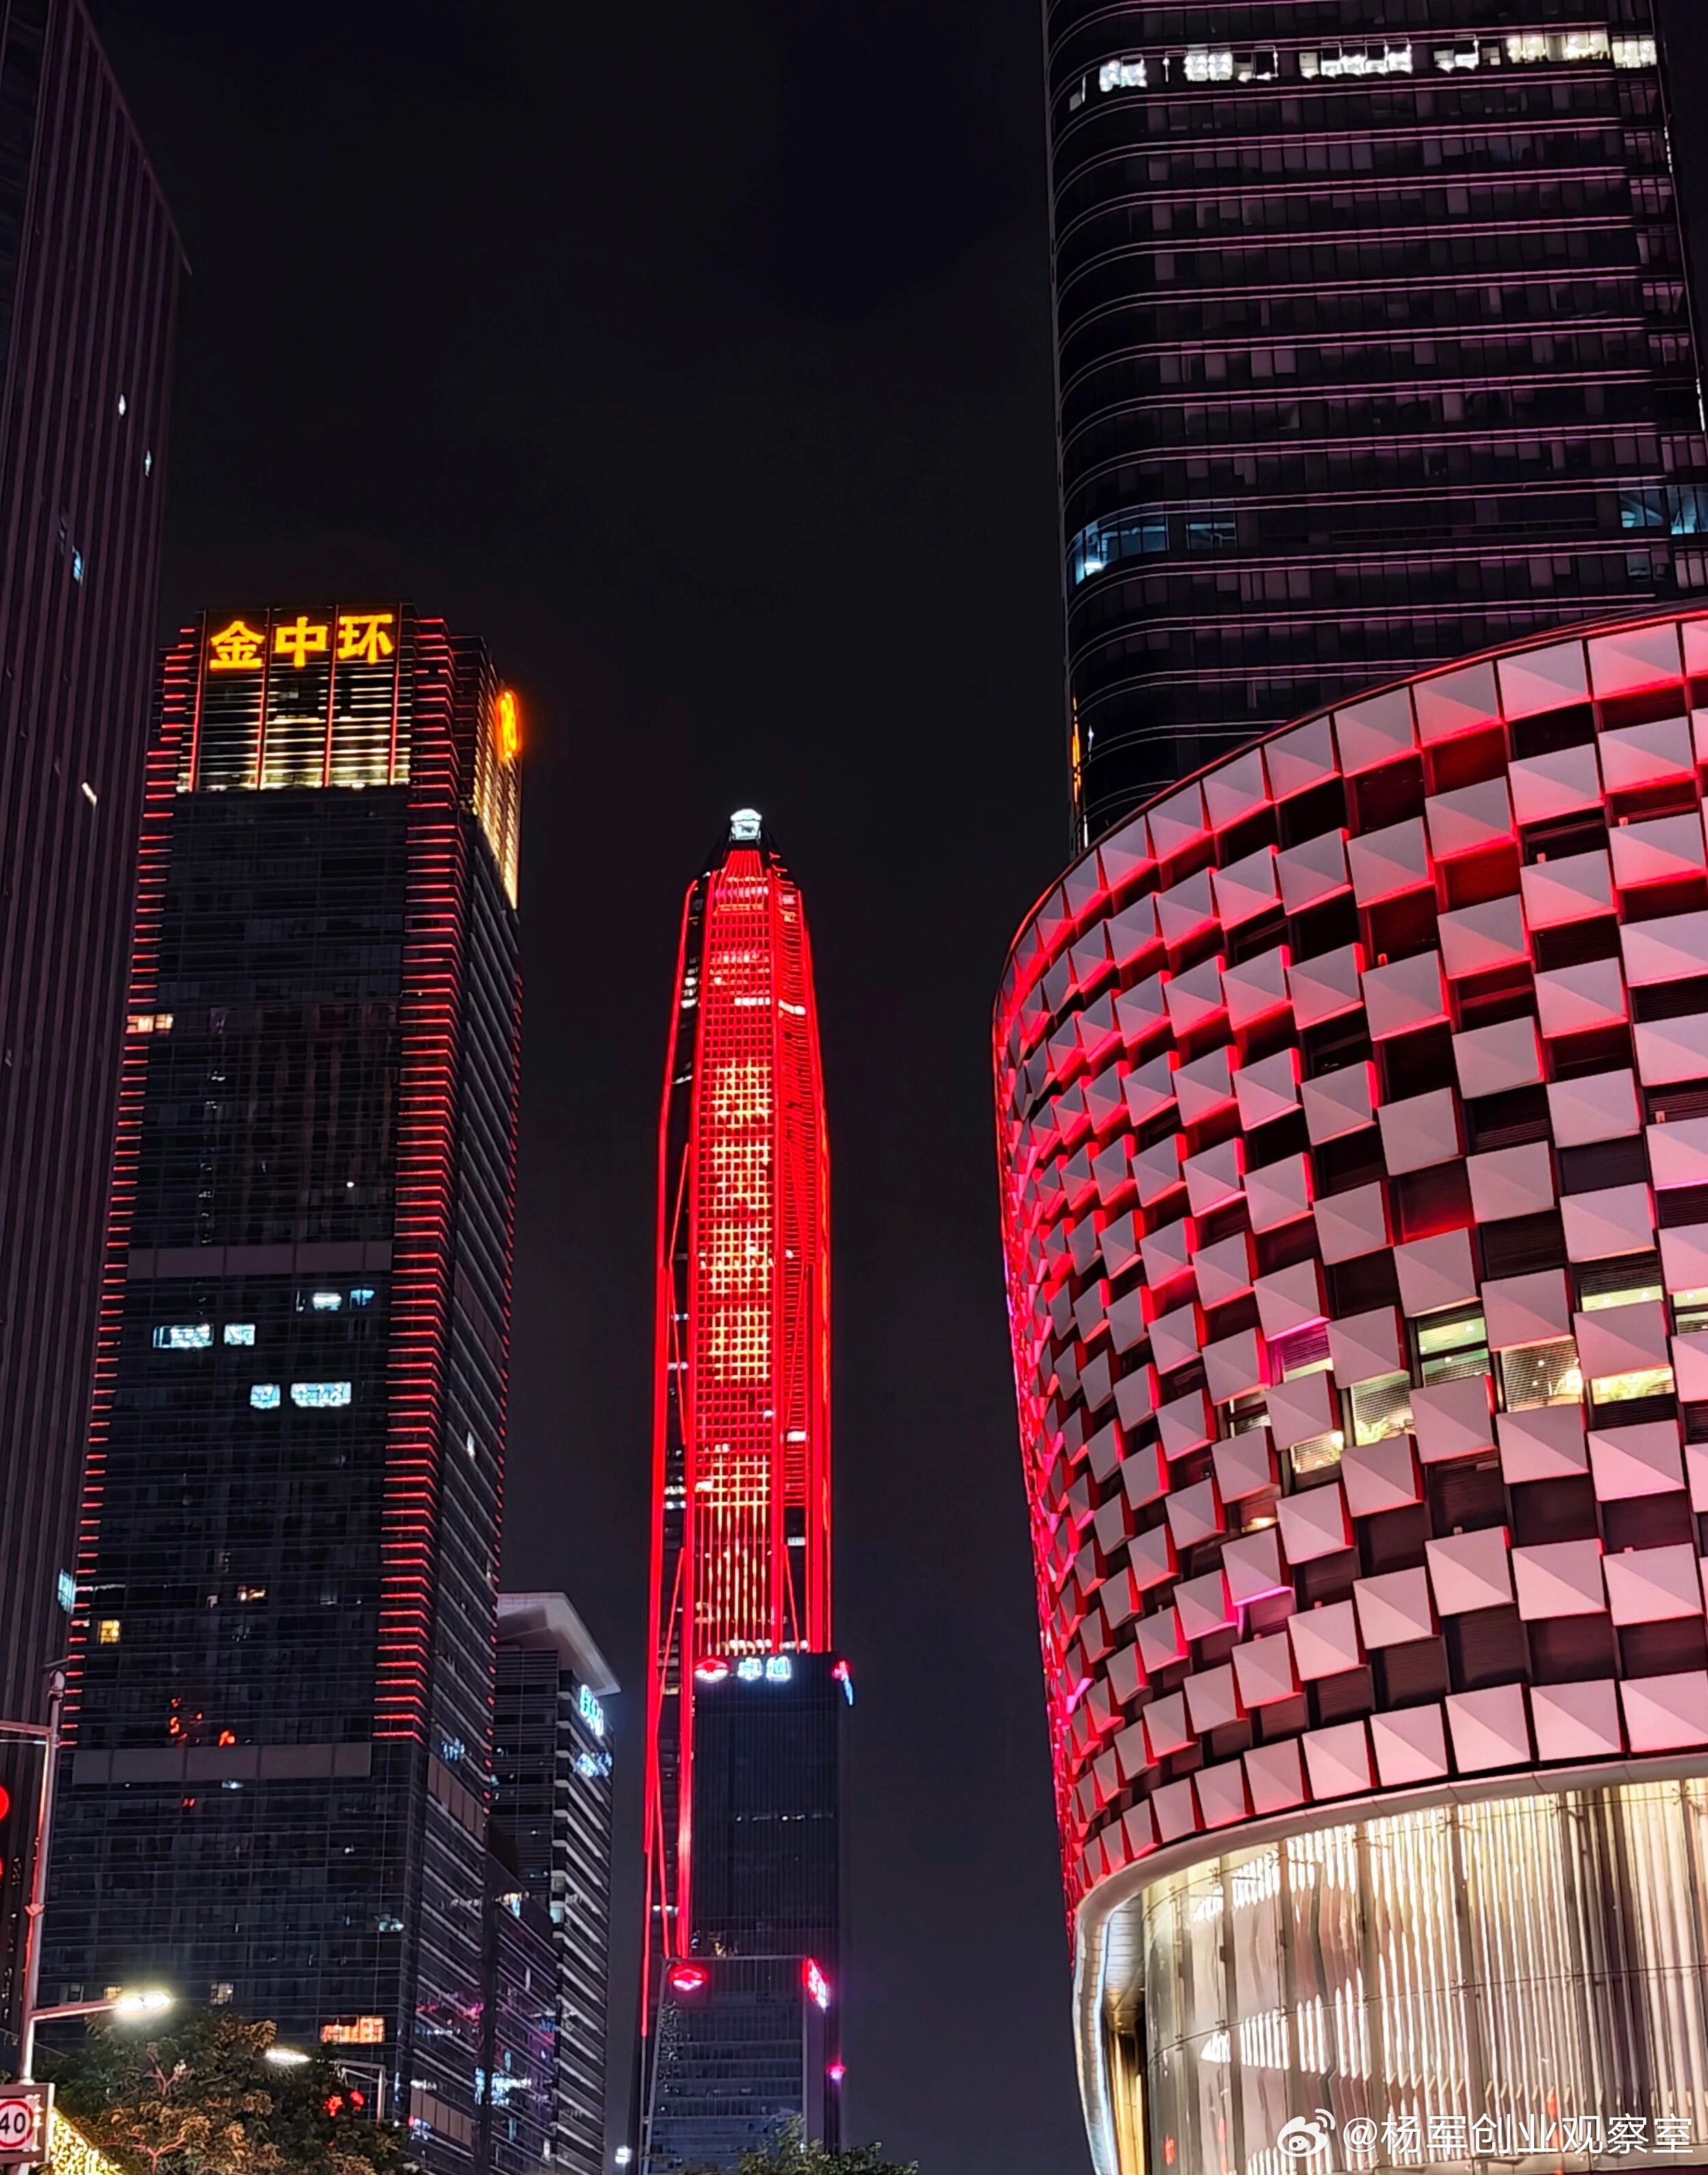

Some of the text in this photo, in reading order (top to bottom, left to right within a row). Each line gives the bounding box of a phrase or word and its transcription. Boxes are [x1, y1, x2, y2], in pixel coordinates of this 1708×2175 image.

[209, 614, 393, 670] 金中环
[0, 2111, 26, 2135] 40
